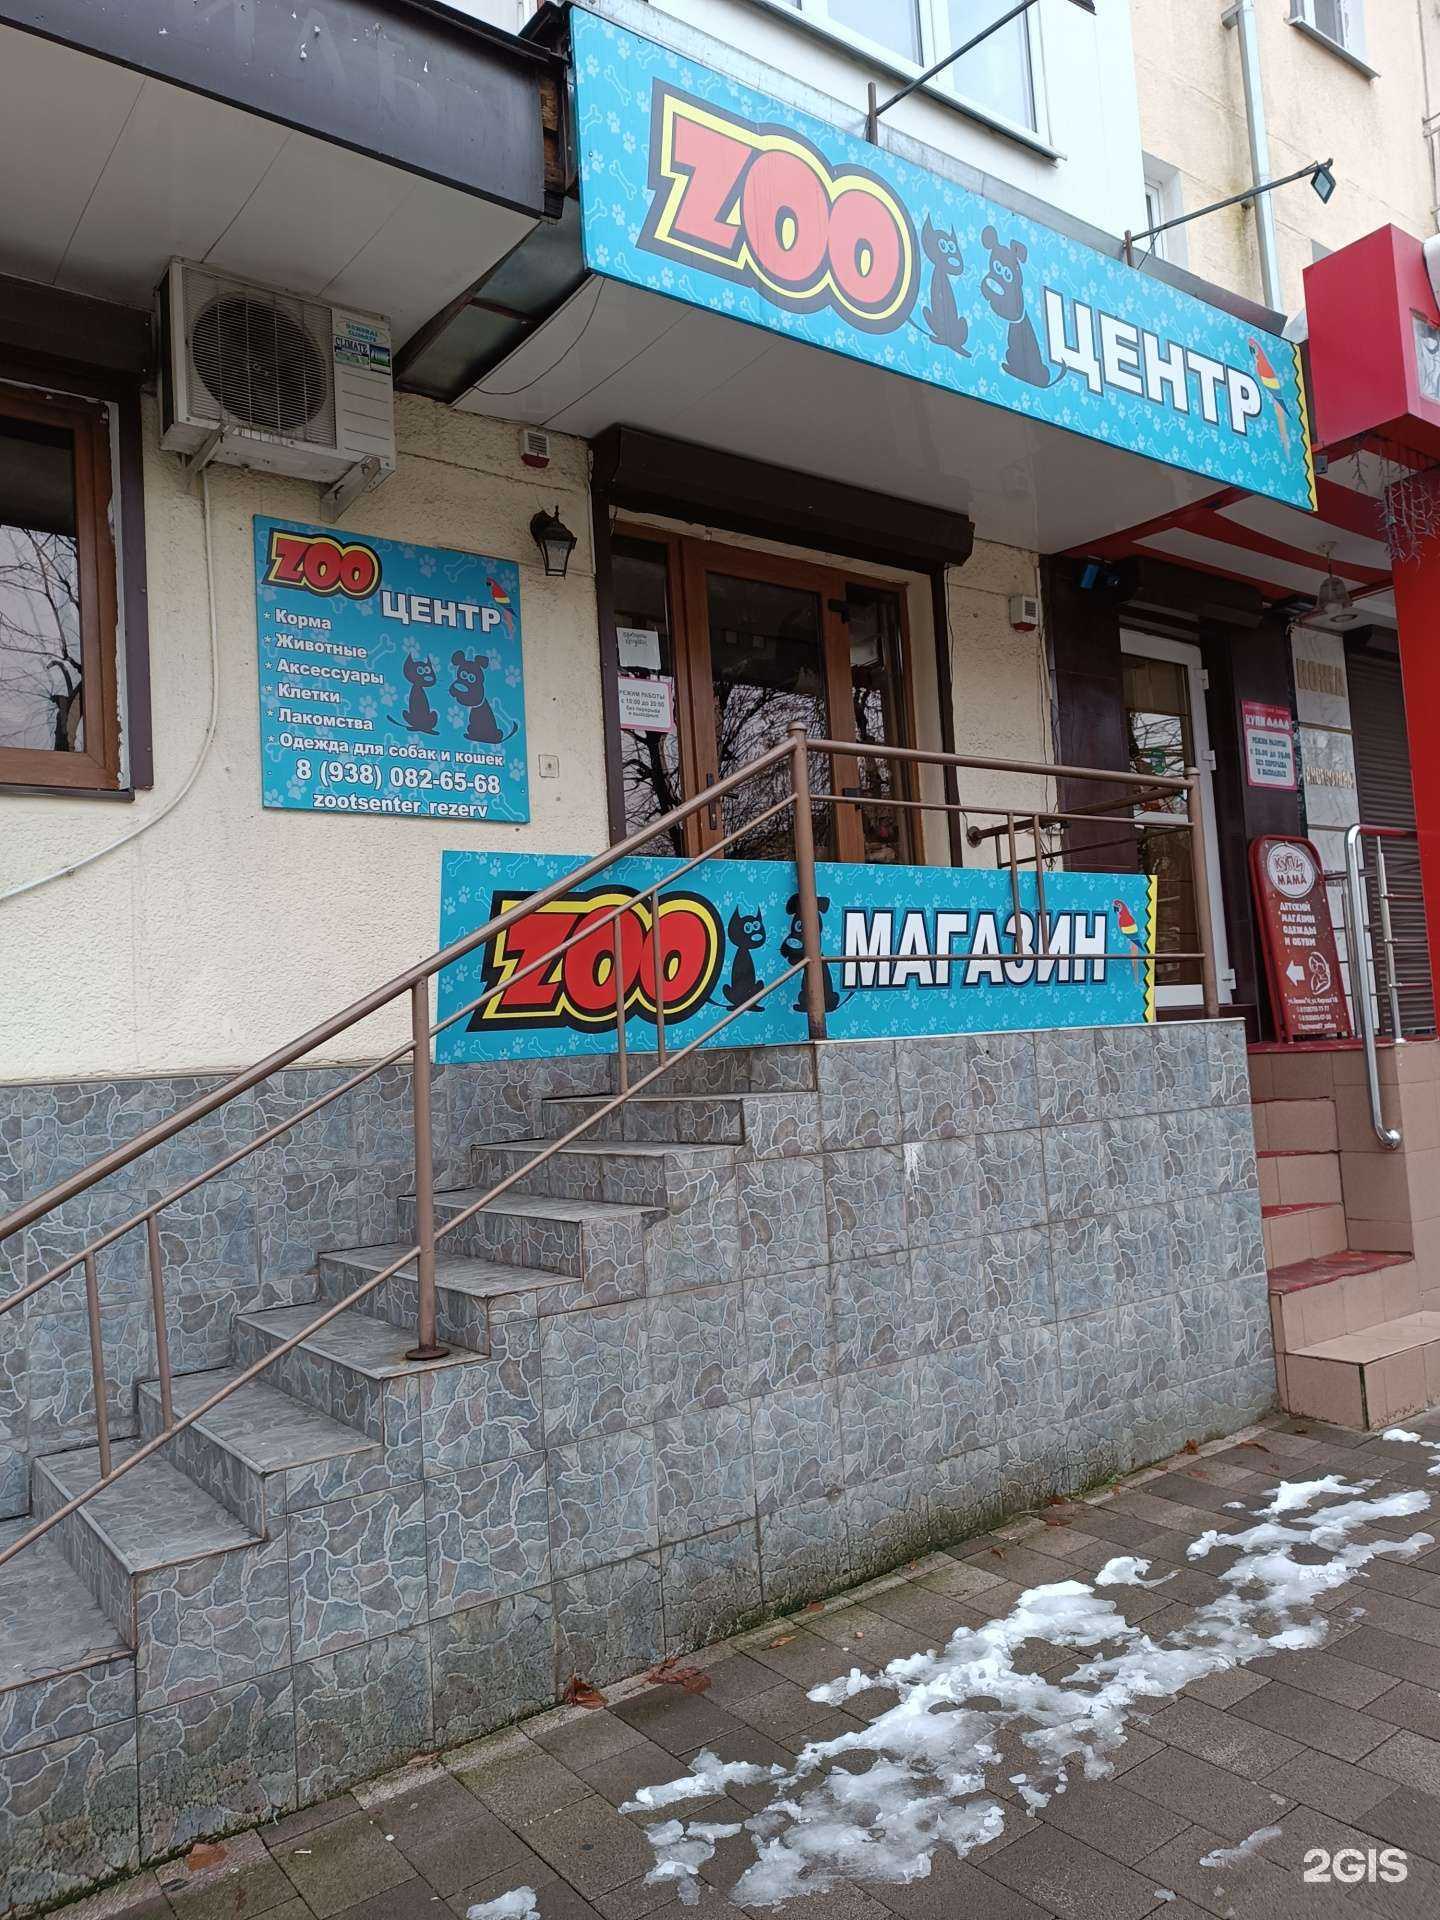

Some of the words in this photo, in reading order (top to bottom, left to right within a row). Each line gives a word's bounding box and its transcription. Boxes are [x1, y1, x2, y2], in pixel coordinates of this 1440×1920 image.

[645, 86, 914, 326] ZOO
[1042, 287, 1261, 434] ЦЕНТР
[265, 530, 380, 598] ZOO
[274, 608, 332, 630] Корма
[380, 590, 500, 632] ЦЕНТР
[275, 633, 368, 658] Животные
[276, 659, 384, 685] Аксессуары
[278, 683, 341, 703] Клетки
[278, 707, 374, 731] Лакомства
[279, 732, 349, 754] Одежда
[353, 743, 384, 757] для
[389, 743, 437, 761] собак
[441, 751, 451, 761] и
[455, 751, 504, 767] кошек
[296, 758, 311, 780] 8
[319, 760, 382, 790] (938)
[389, 767, 501, 794] 082-65-68
[1277, 874, 1307, 885] МАМА
[1281, 913, 1315, 923] МАГАЗИН
[474, 887, 725, 1027] ZOO
[842, 908, 1107, 991] МАГАЗИН
